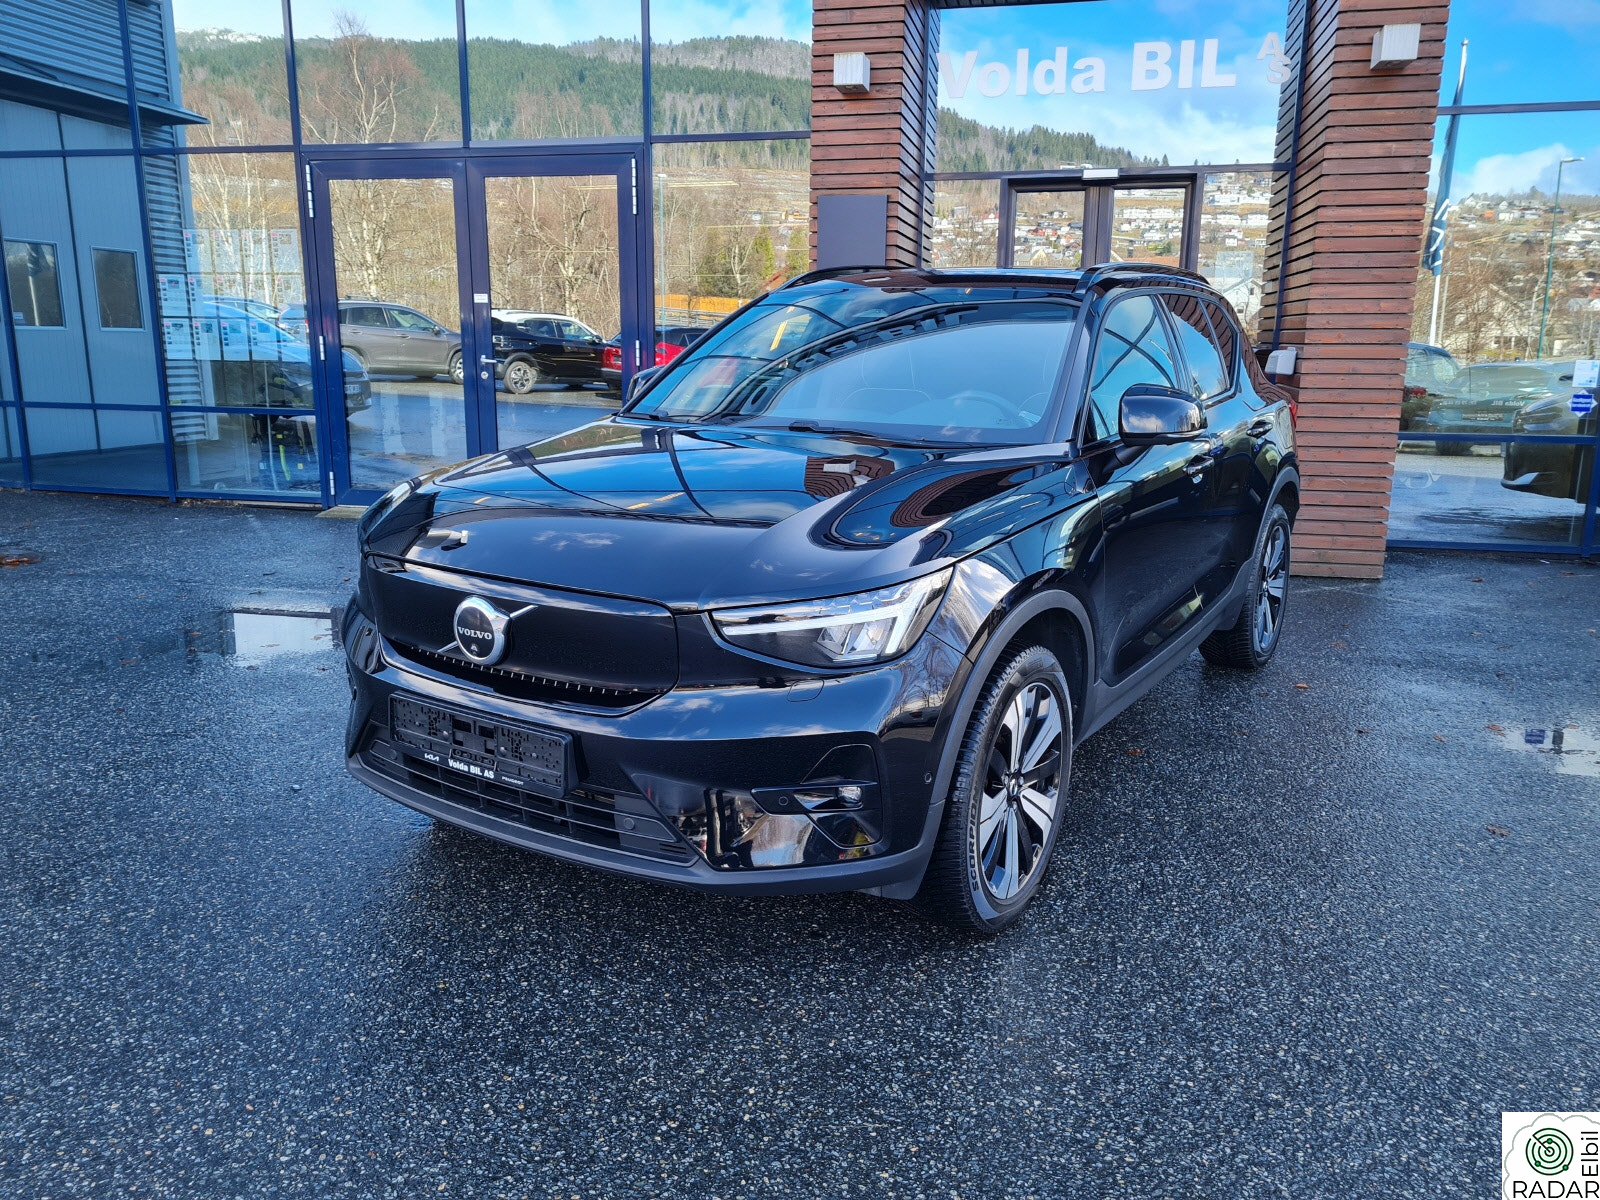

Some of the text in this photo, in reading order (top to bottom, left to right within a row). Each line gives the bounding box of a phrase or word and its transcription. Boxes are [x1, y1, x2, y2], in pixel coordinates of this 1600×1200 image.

[938, 47, 1106, 98] Volda
[1131, 39, 1236, 91] BIL
[457, 626, 493, 640] VOLVO
[448, 758, 495, 779] Volda BIL AS
